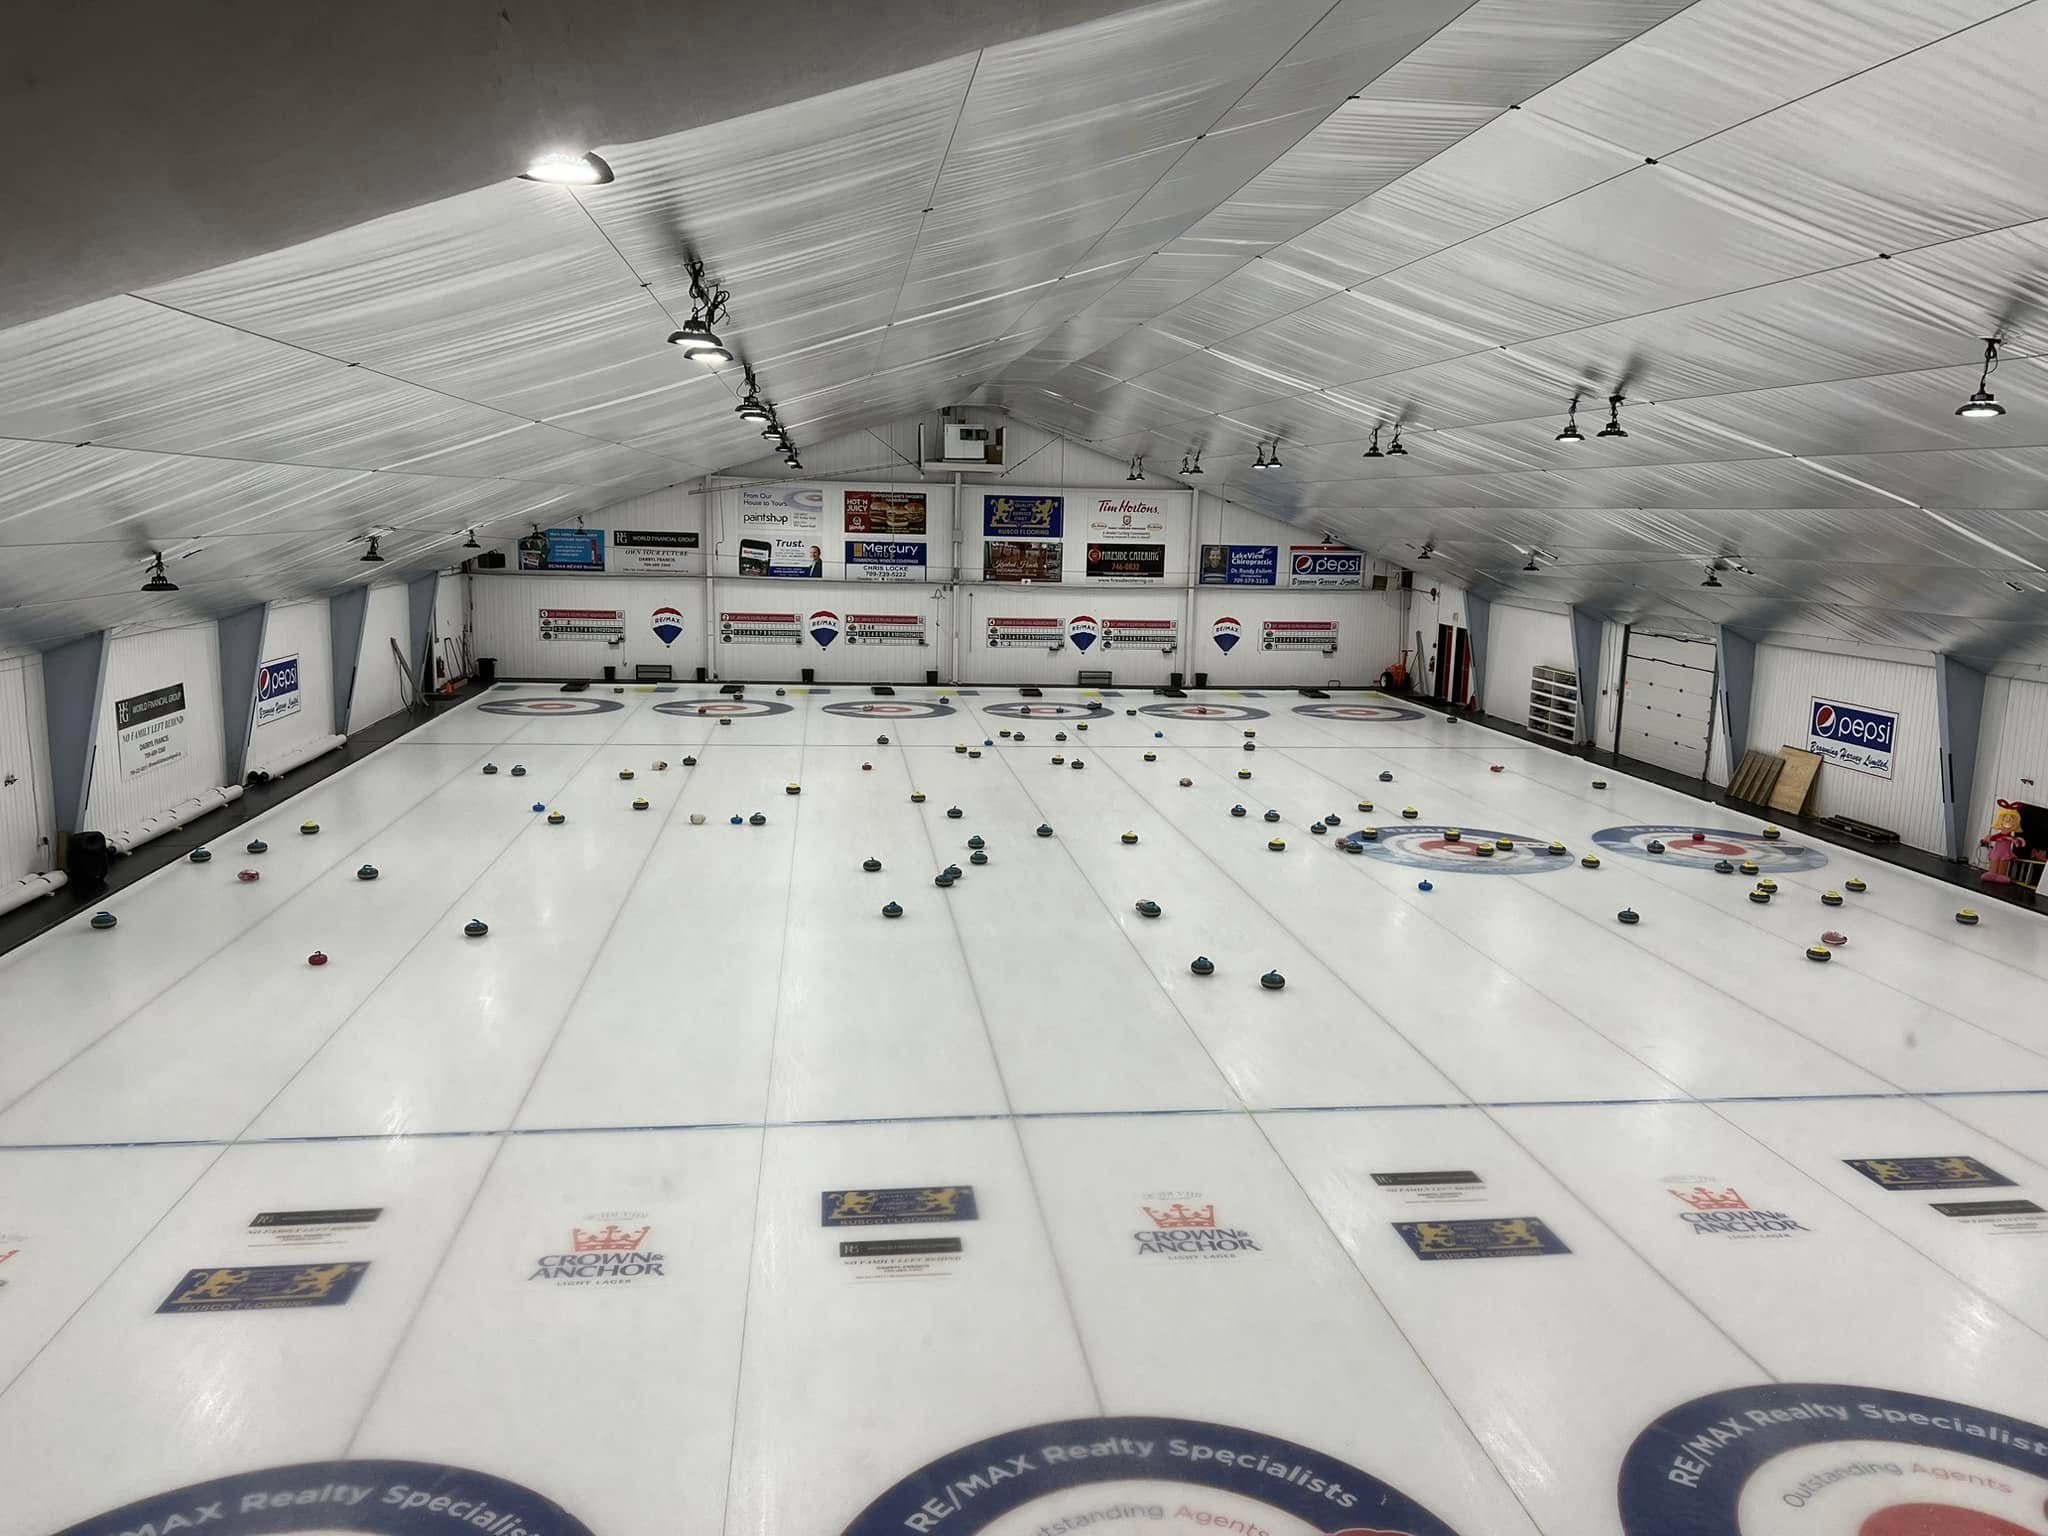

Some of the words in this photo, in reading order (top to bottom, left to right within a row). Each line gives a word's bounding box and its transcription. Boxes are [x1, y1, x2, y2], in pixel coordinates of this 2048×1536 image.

[1098, 500, 1117, 512] Tim
[743, 512, 789, 526] paintshop
[775, 539, 805, 548] Trust.
[863, 543, 918, 556] Mercury
[1102, 551, 1128, 560] FIRESIDE
[1129, 551, 1159, 561] CATERING
[1315, 557, 1360, 573] pepsi
[272, 663, 297, 693] pepsi
[133, 703, 147, 713] WORLD
[148, 697, 168, 709] FINANCIAL
[169, 692, 181, 704] GROUP
[131, 727, 150, 740] FAMILY
[151, 721, 164, 734] LEFT
[1838, 716, 1892, 744] pepsi
[1693, 1220, 1812, 1235] ANCHOR
[1138, 1239, 1263, 1255] ANCHOR
[527, 1264, 665, 1281] ANCHOR
[1668, 1416, 1754, 1488] RE/MAX
[1744, 1402, 1850, 1428] Realty
[904, 1453, 1037, 1535] RE/MAX
[1043, 1438, 1155, 1466] Realty
[1168, 1439, 1358, 1509] Specialists
[1782, 1460, 1904, 1510] Outstanding
[1910, 1461, 2012, 1494] Agents
[240, 1484, 375, 1515] Realty
[381, 1485, 541, 1536] Specialis
